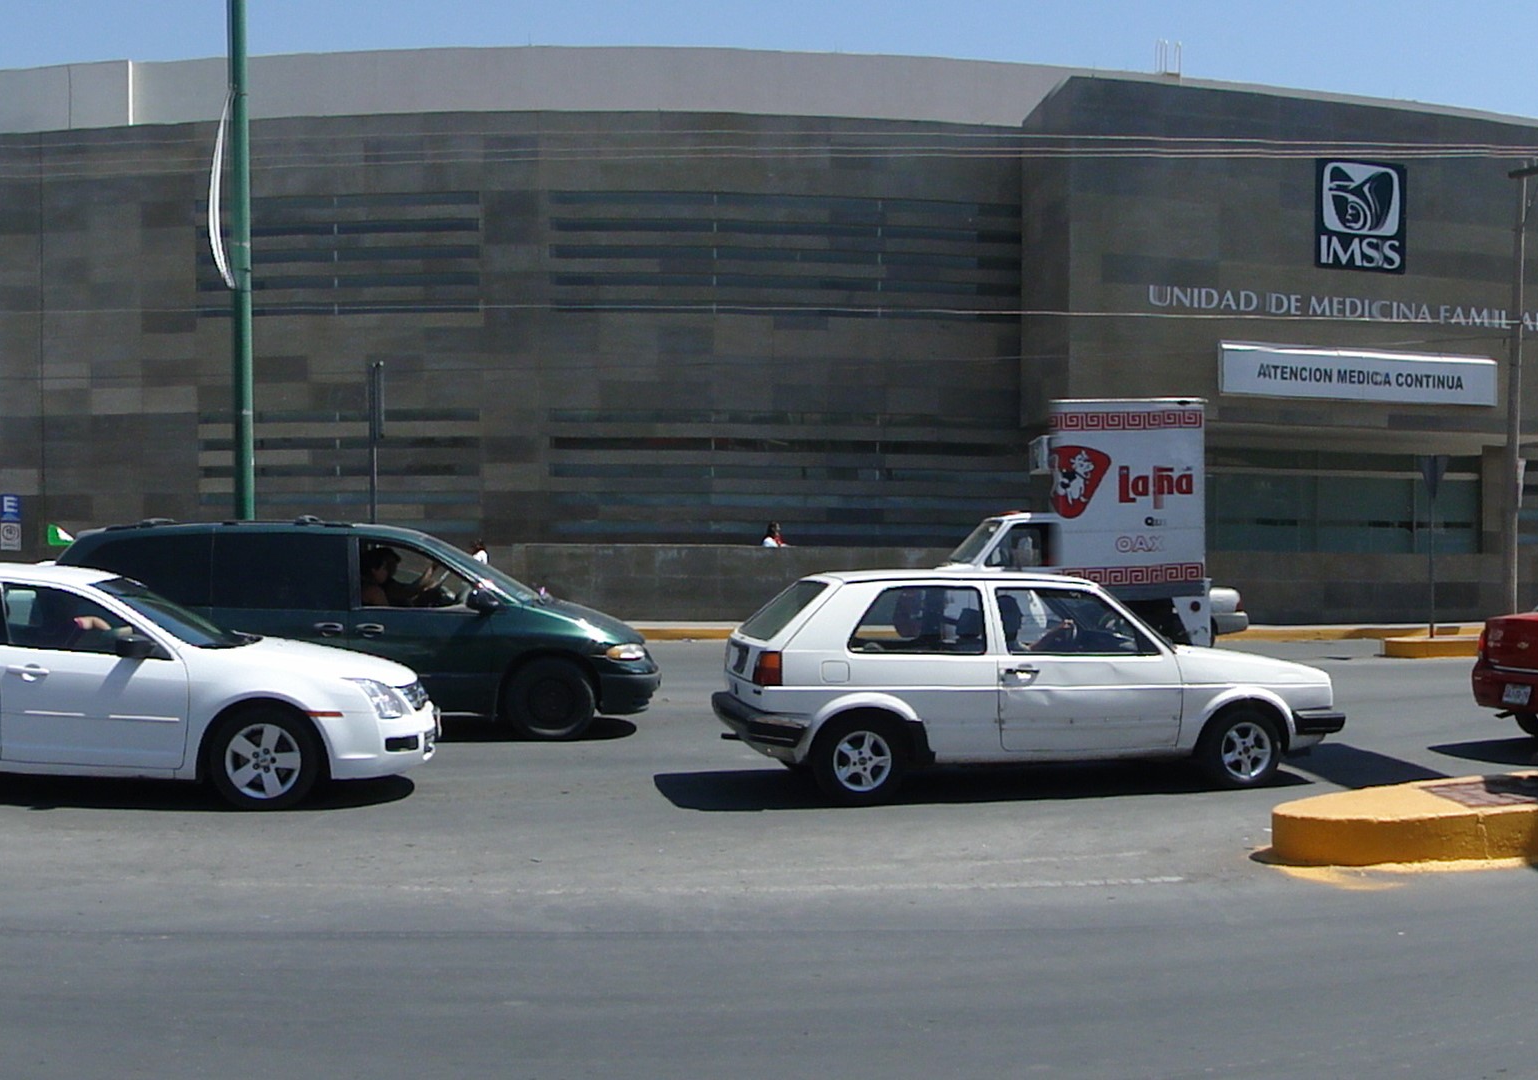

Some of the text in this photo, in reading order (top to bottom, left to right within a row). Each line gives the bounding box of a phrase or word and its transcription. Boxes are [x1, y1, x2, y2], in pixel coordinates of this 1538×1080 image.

[1319, 235, 1401, 270] IMSS
[1149, 284, 1258, 312] UNIDAD
[1266, 292, 1302, 316] DE
[1309, 296, 1433, 323] MEDICINA
[1257, 362, 1464, 390] ATENCION MEDICA CONTINUA
[4, 496, 18, 513] E
